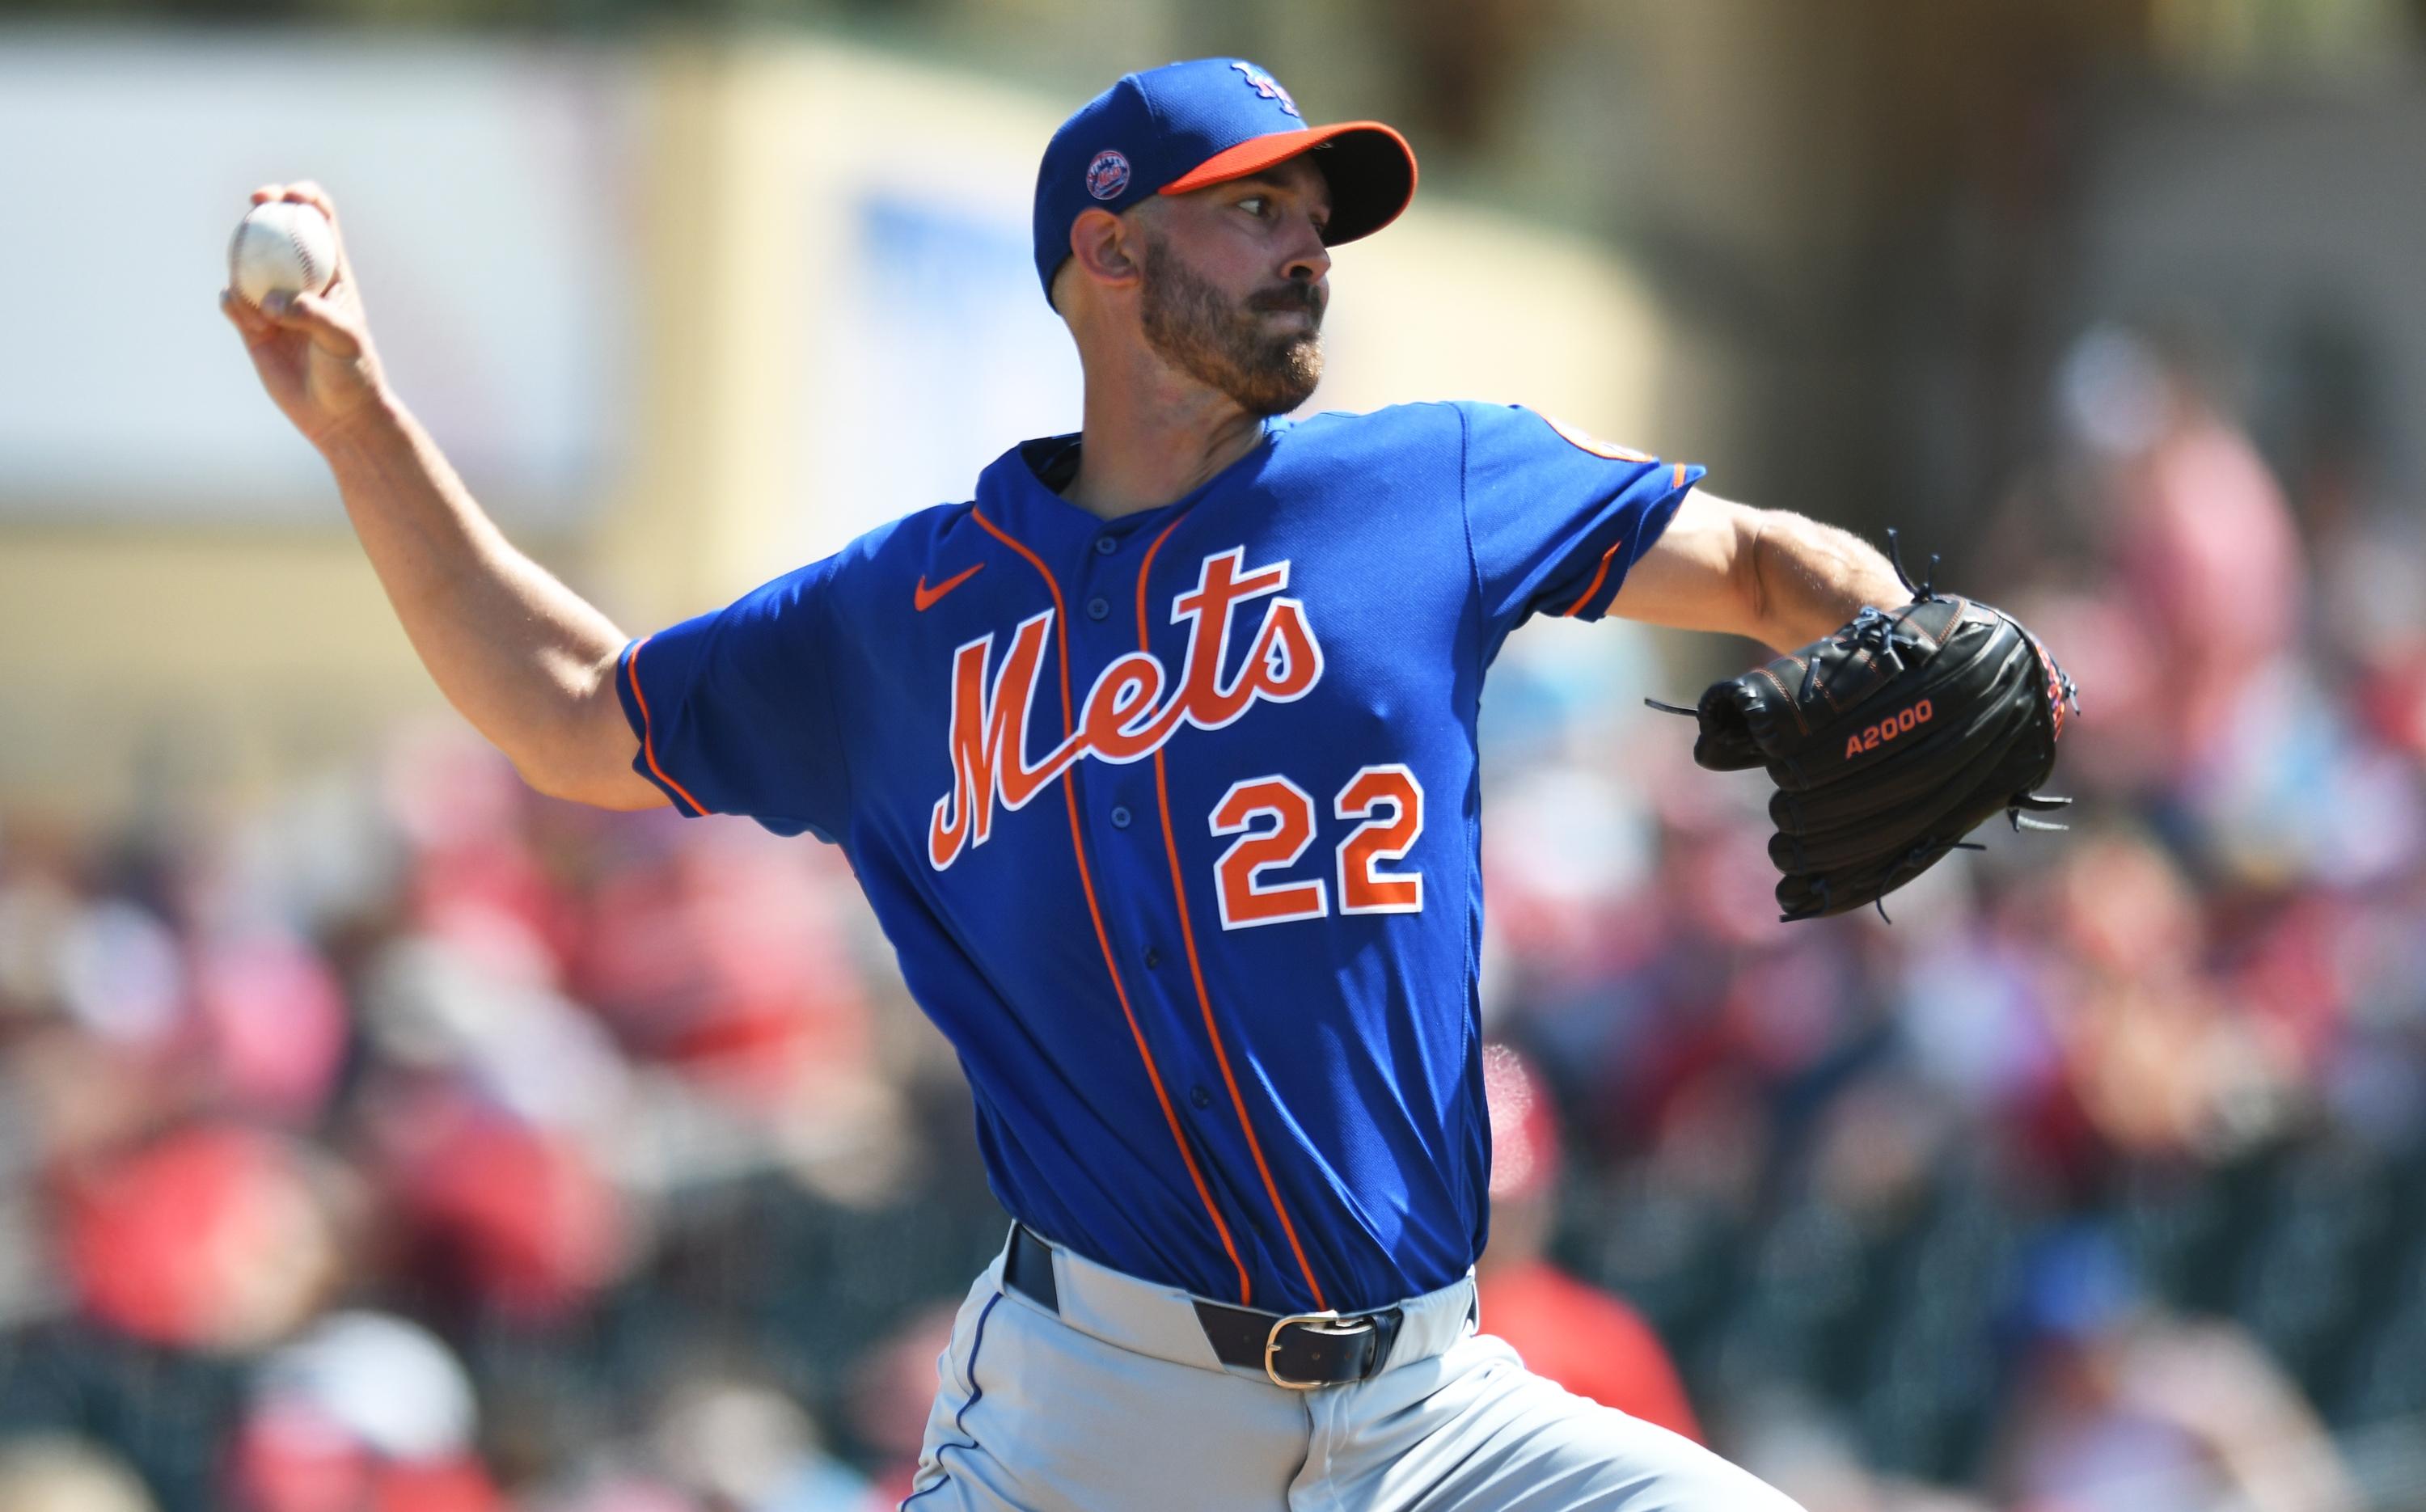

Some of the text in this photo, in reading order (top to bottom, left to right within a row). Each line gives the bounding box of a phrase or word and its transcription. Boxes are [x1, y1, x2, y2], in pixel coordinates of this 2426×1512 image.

[928, 545, 1324, 871] Mets
[1845, 699, 1933, 760] A2000
[1208, 763, 1423, 931] 22
